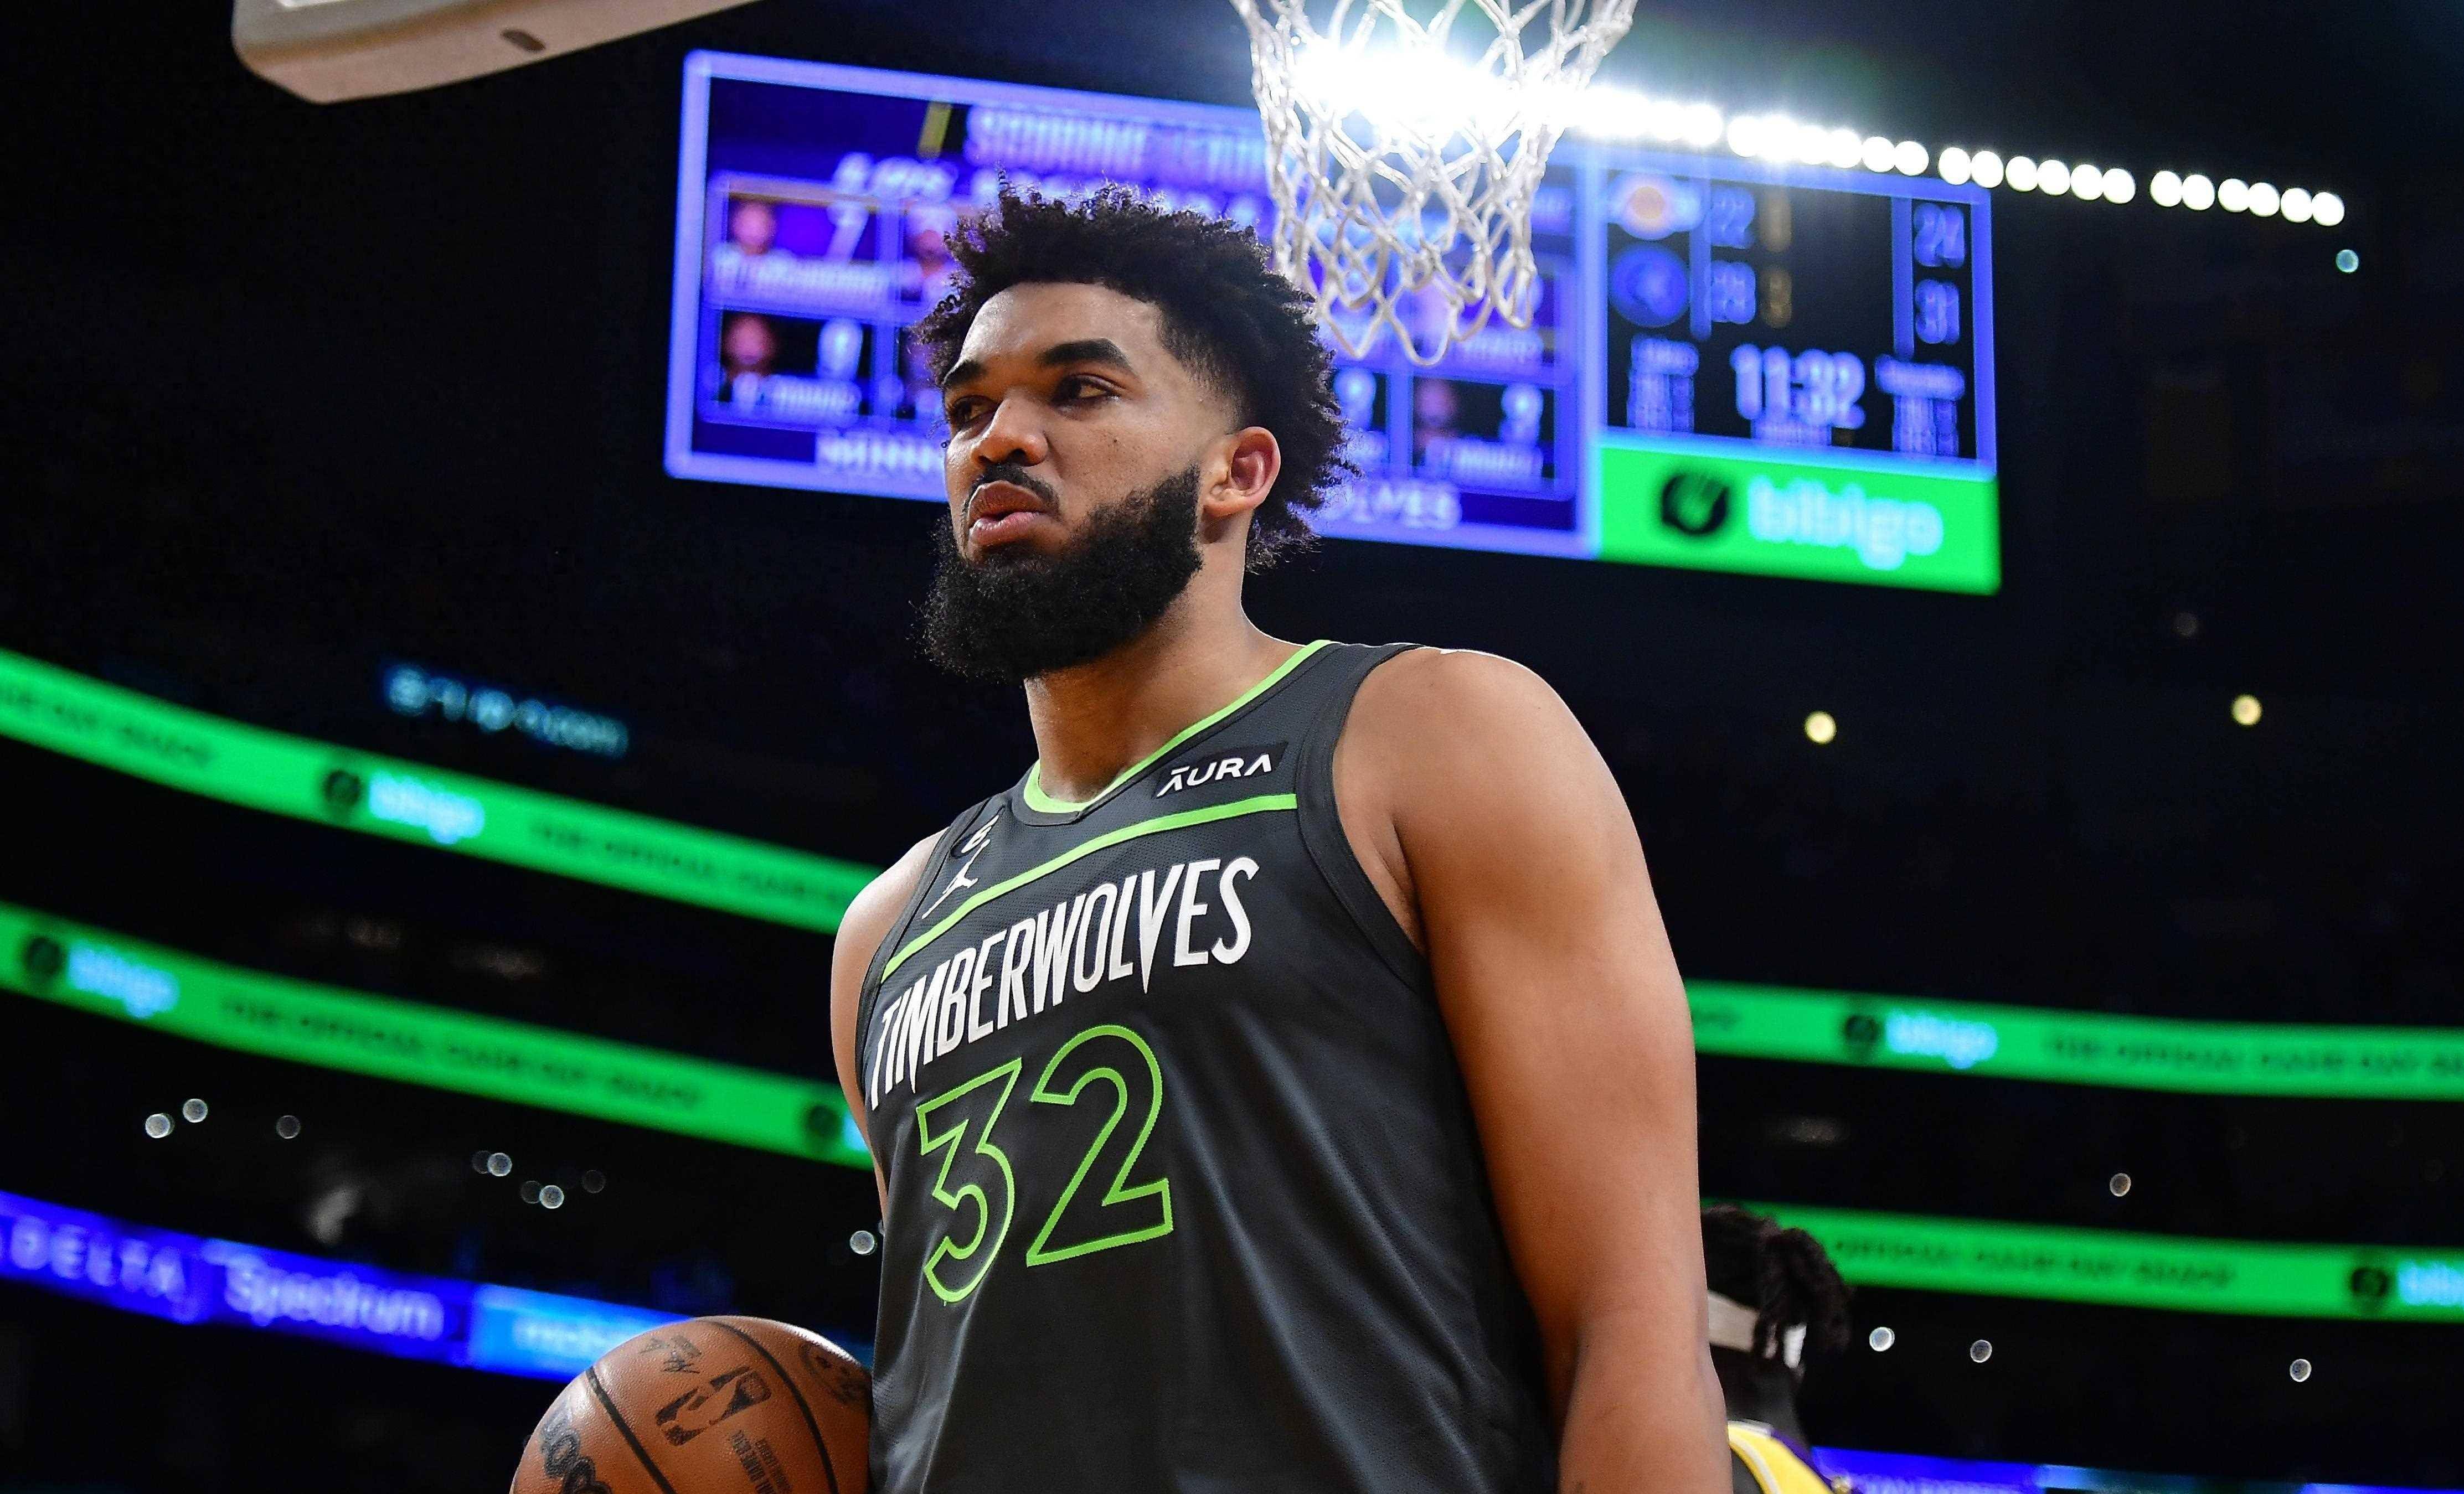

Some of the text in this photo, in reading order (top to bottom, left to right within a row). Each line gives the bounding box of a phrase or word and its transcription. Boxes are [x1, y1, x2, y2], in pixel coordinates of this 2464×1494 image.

[872, 856, 1260, 1111] TIMBERWOLVES
[10, 1216, 185, 1304] DELTA
[915, 1023, 1174, 1305] 32
